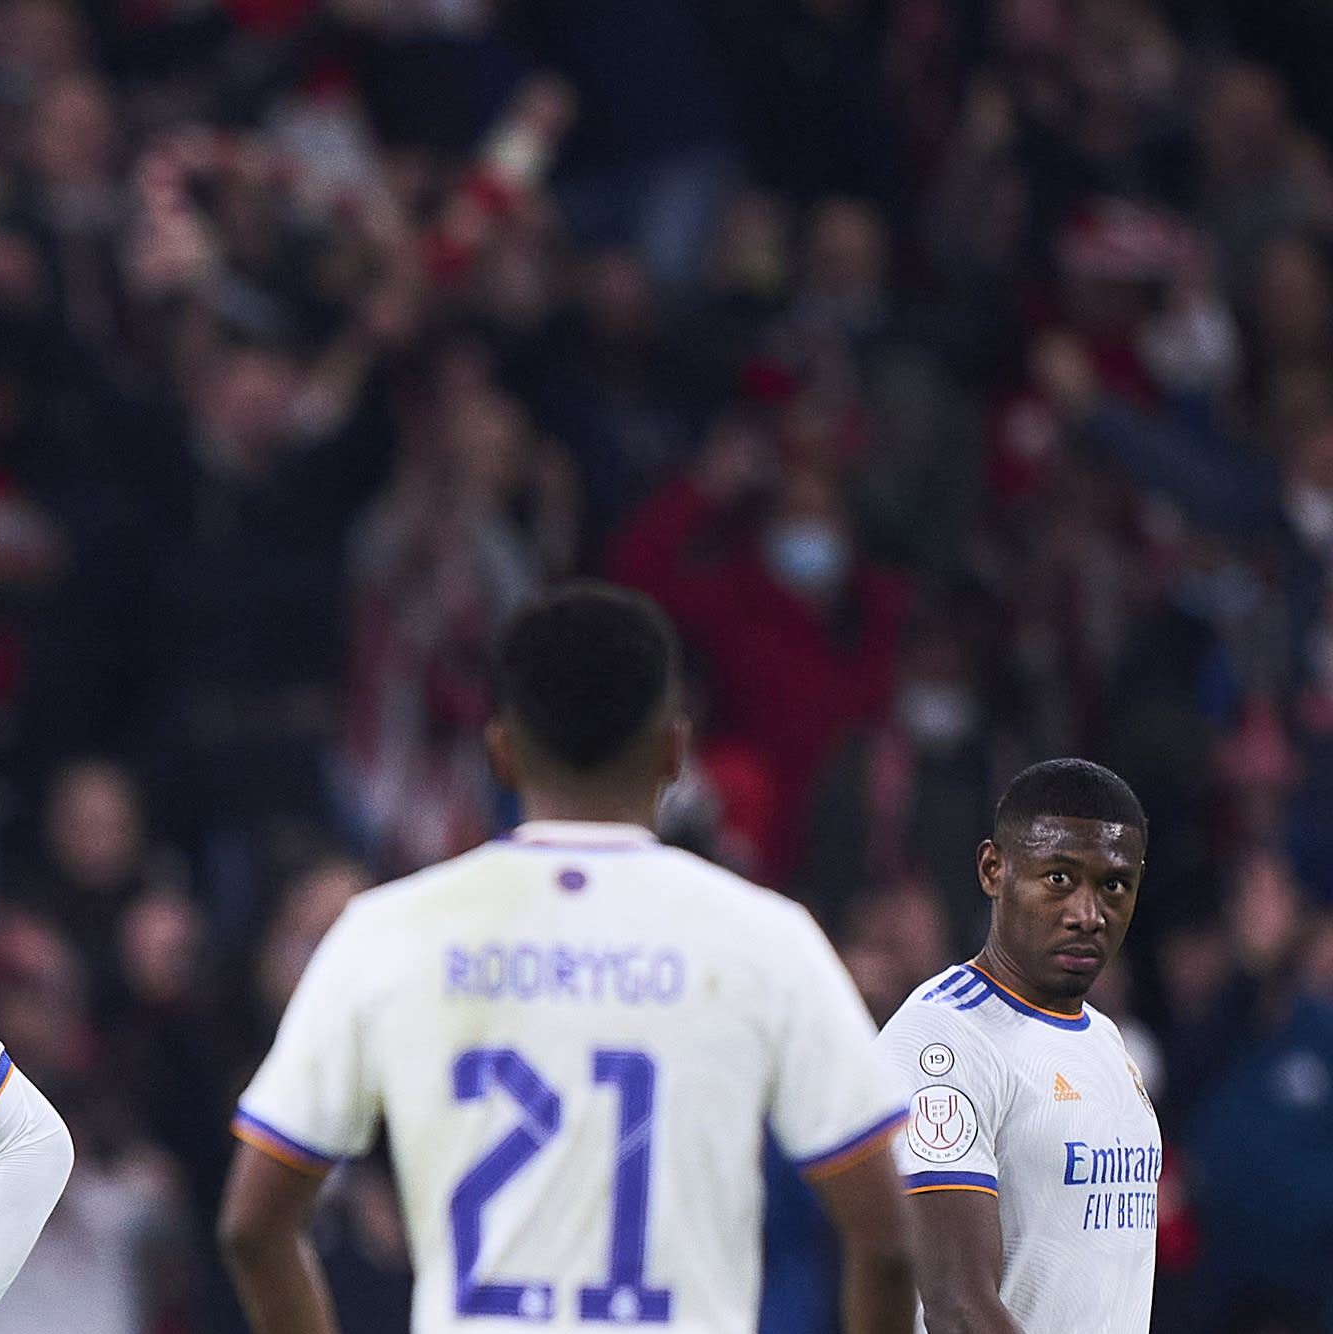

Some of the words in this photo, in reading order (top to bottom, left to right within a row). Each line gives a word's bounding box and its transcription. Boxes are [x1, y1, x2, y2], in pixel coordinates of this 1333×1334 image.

[444, 946, 687, 1003] RODRYGO
[929, 1054, 945, 1065] 19
[449, 1047, 671, 1323] 21
[1064, 1137, 1161, 1185] Emirate
[1083, 1193, 1112, 1230] FLY
